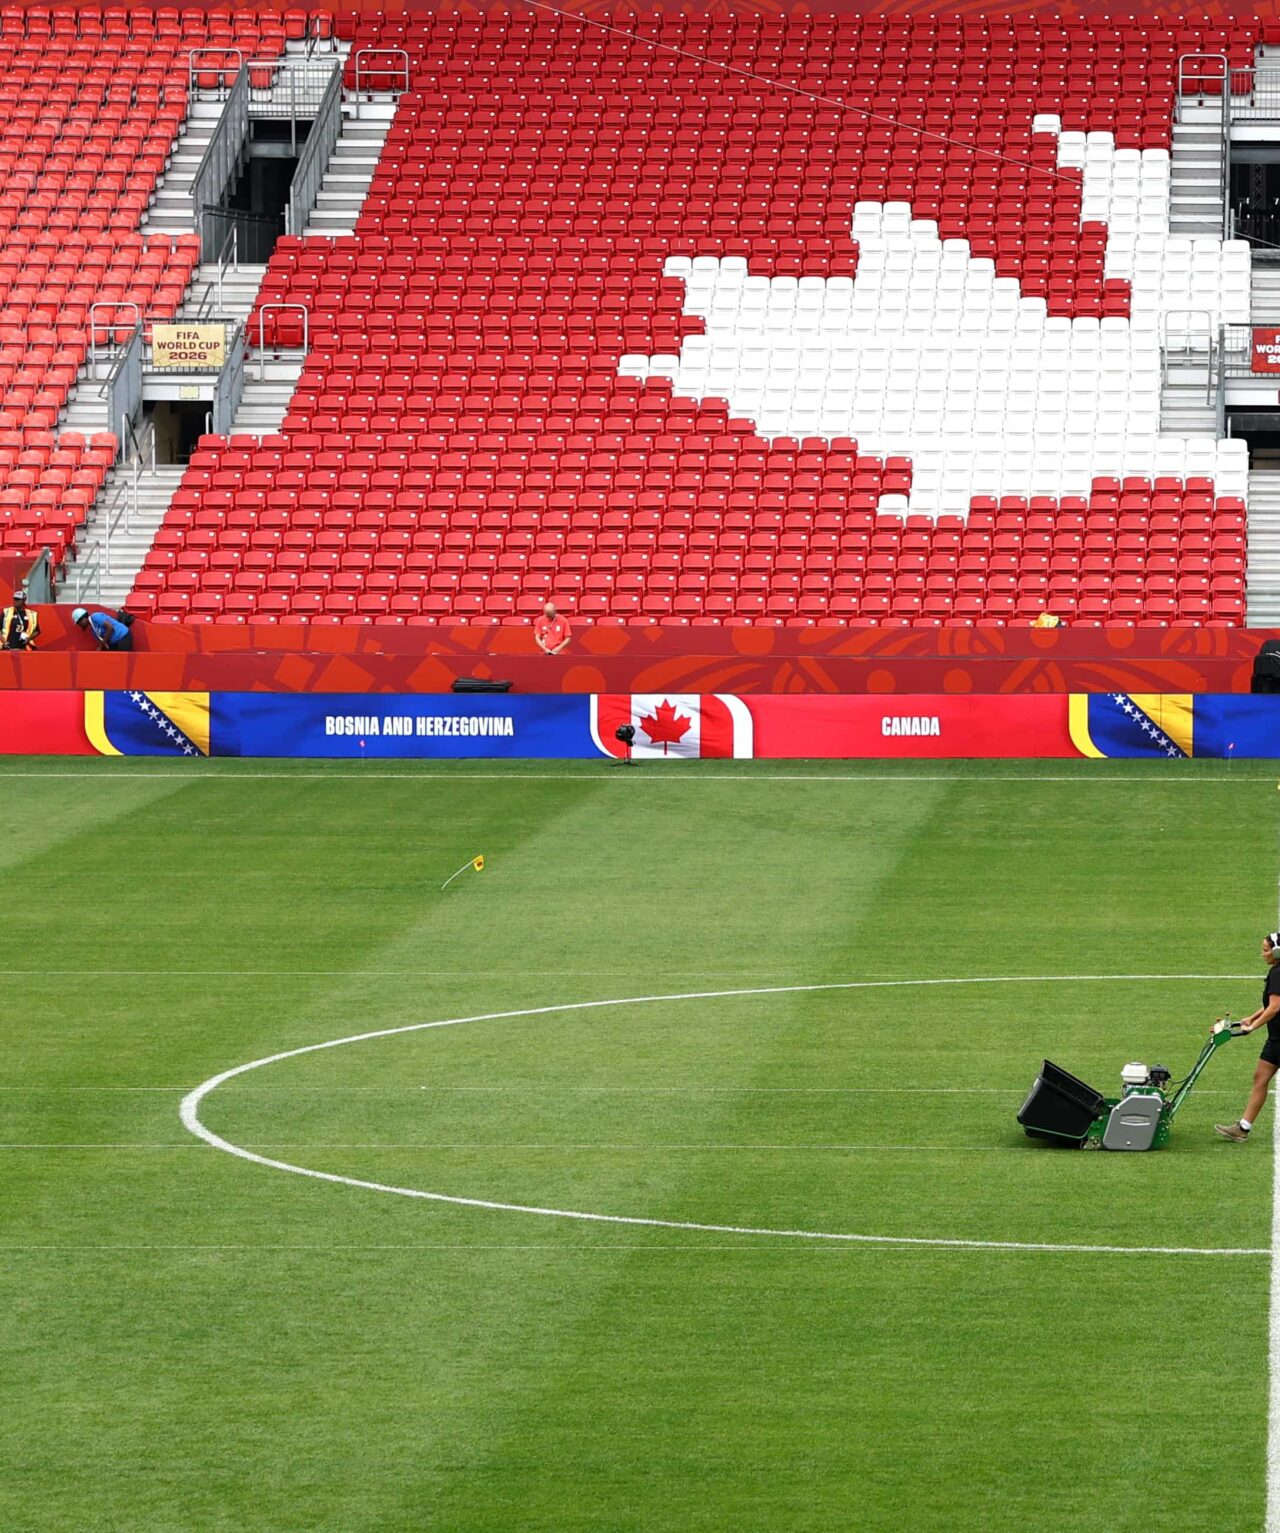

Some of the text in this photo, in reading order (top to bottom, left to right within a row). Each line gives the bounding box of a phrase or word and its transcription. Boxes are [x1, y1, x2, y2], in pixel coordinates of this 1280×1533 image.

[176, 331, 200, 340] FIFA
[157, 341, 220, 350] WORLD CUP
[168, 351, 208, 360] 2026
[325, 716, 514, 737] BOSNIA AND HERZEGOVINA
[881, 716, 941, 737] CANADA
